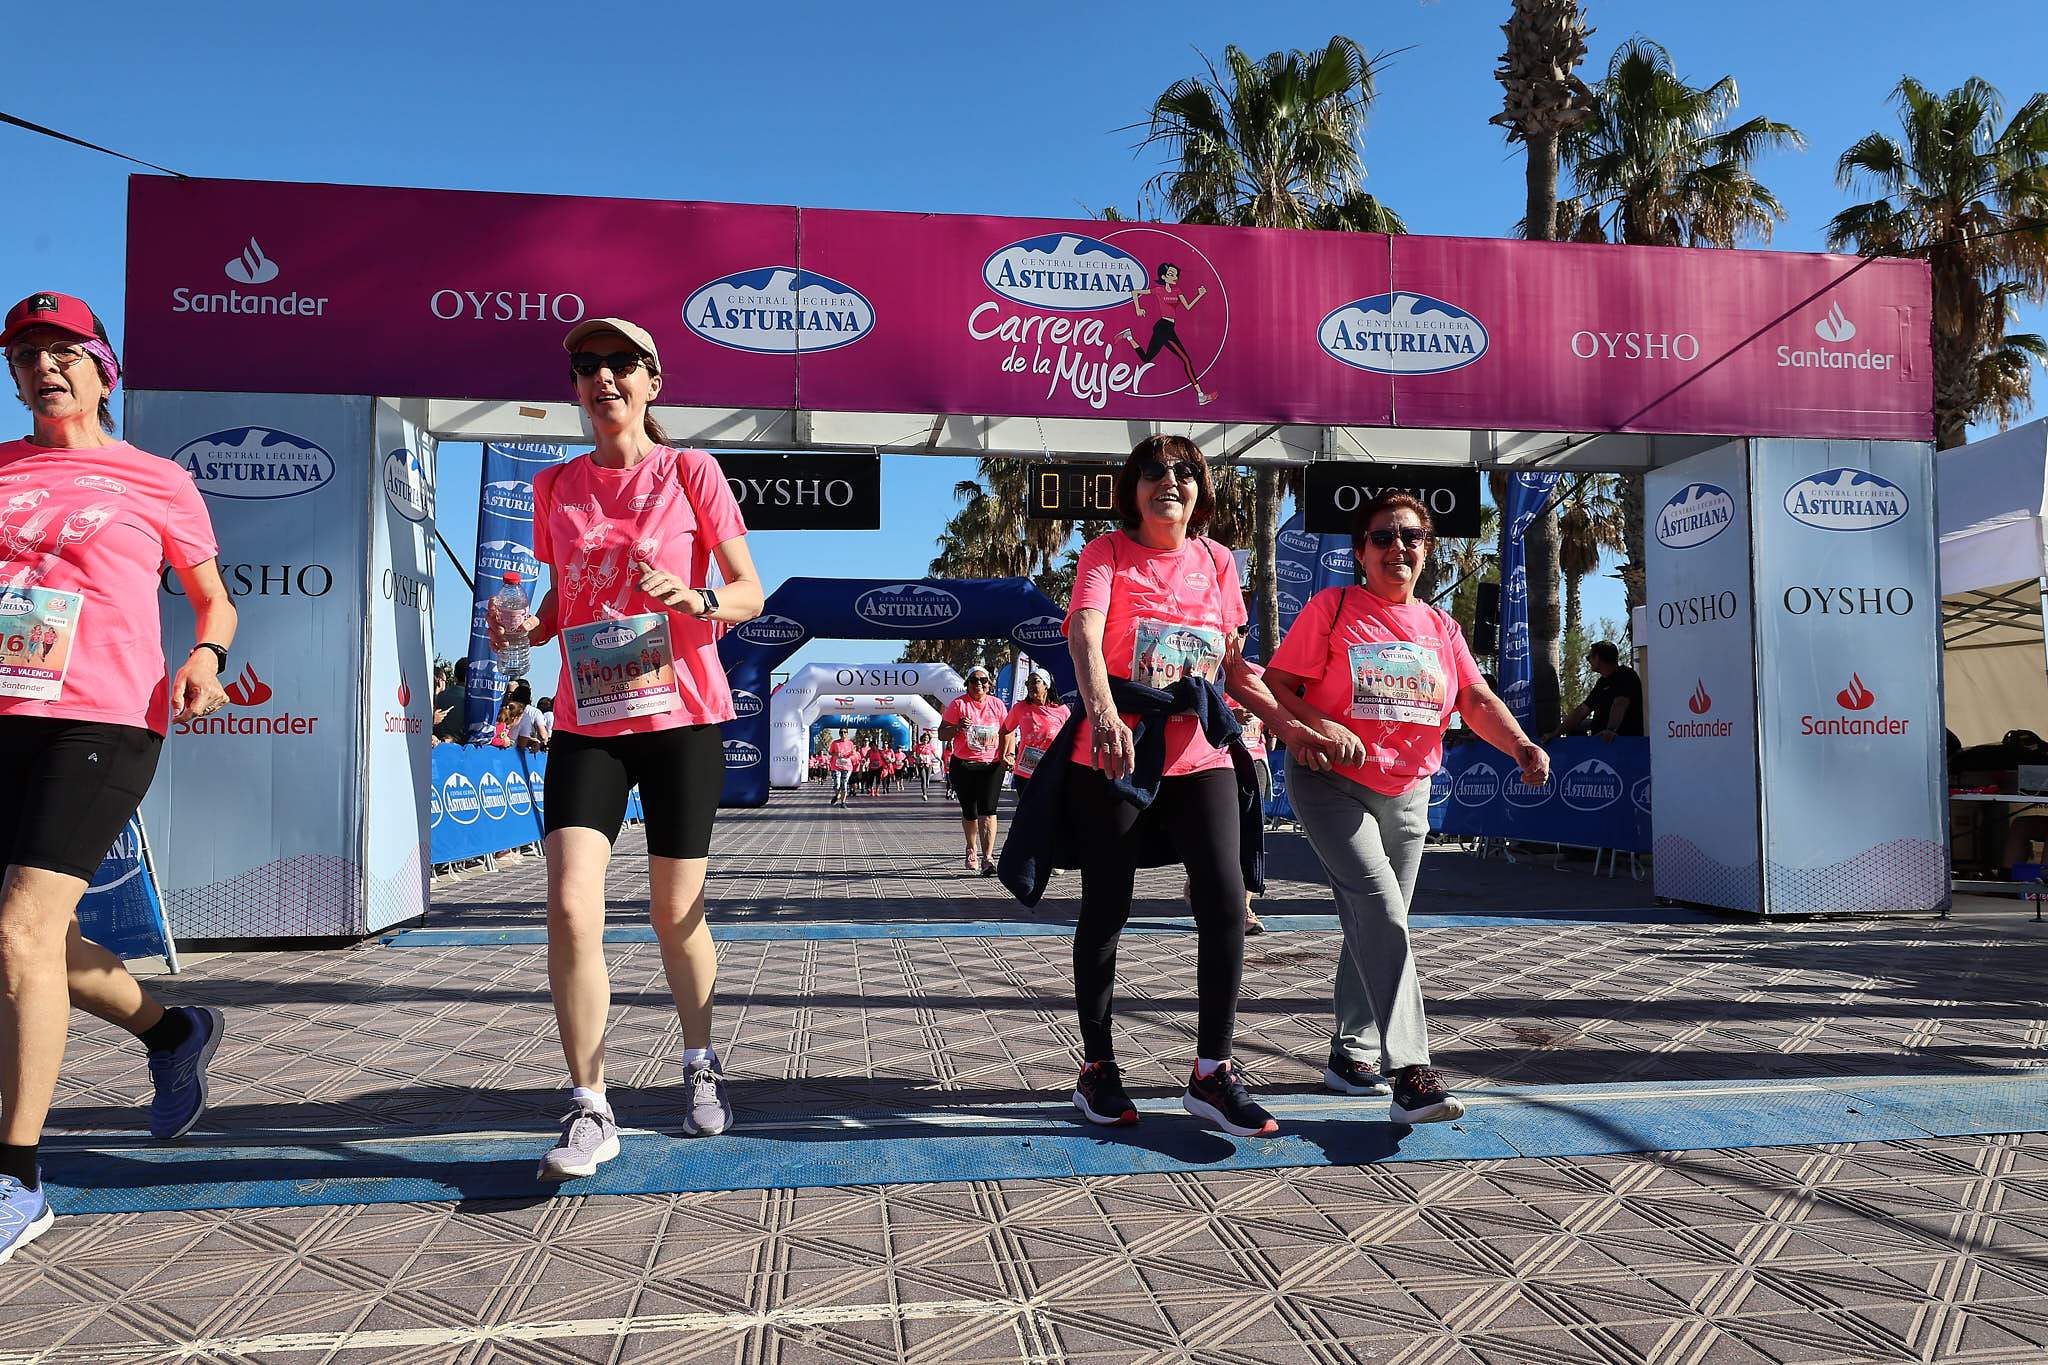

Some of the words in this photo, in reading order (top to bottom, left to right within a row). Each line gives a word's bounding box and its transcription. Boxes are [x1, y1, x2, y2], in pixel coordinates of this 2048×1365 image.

[1021, 257, 1073, 268] CENTRAL
[1078, 260, 1130, 270] LECHERA
[995, 258, 1136, 293] ASTURIANA
[172, 287, 328, 317] Santander
[430, 289, 585, 323] OYSHO
[727, 295, 787, 306] CENTRAL
[697, 296, 861, 333] ASTURIANA
[967, 301, 1105, 346] Carrera
[1409, 320, 1471, 331] LECHERA
[1333, 319, 1477, 356] ASTURIANA
[1570, 330, 1700, 362] OYSHO
[1776, 344, 1895, 371] Santander
[1001, 344, 1027, 373] de
[1032, 345, 1051, 374] la
[1046, 344, 1156, 409] Mujer
[185, 451, 323, 482] ASTURIANA
[207, 451, 261, 460] CENTRAL
[265, 452, 318, 461] LECHERA
[727, 478, 854, 507] OYSHO
[1810, 489, 1852, 497] CENTRAL
[1853, 489, 1896, 498] LECHERA
[1670, 504, 1696, 518] CENTRAL
[1792, 490, 1901, 517] ASTURIANA
[1660, 505, 1729, 539] ASTURIANA
[383, 568, 430, 613] OYSHO
[1783, 586, 1914, 616] OYSHO
[863, 597, 954, 617] ASTURIANA
[1658, 590, 1737, 629] OYSHO
[594, 632, 635, 647] ASTURIANA
[741, 625, 800, 638] ASTURIANA
[1380, 651, 1417, 661] ASTURIANA
[17, 667, 54, 679] VALENCIA
[601, 661, 641, 682] 016
[836, 669, 920, 687] OYSHO
[1383, 674, 1419, 690] 016
[1, 681, 45, 692] Santander
[610, 682, 630, 693] 2493
[610, 693, 619, 701] LA
[618, 691, 639, 701] MUJER
[589, 706, 617, 718] OYSHO
[1362, 707, 1393, 716] OYSHO
[174, 712, 319, 736] Santander
[384, 710, 423, 736] Santander
[1667, 717, 1734, 738] Santander
[1800, 715, 1909, 736] Santander
[1456, 780, 1495, 796] ASTURIANA
[1563, 777, 1615, 799] ASTURIANA
